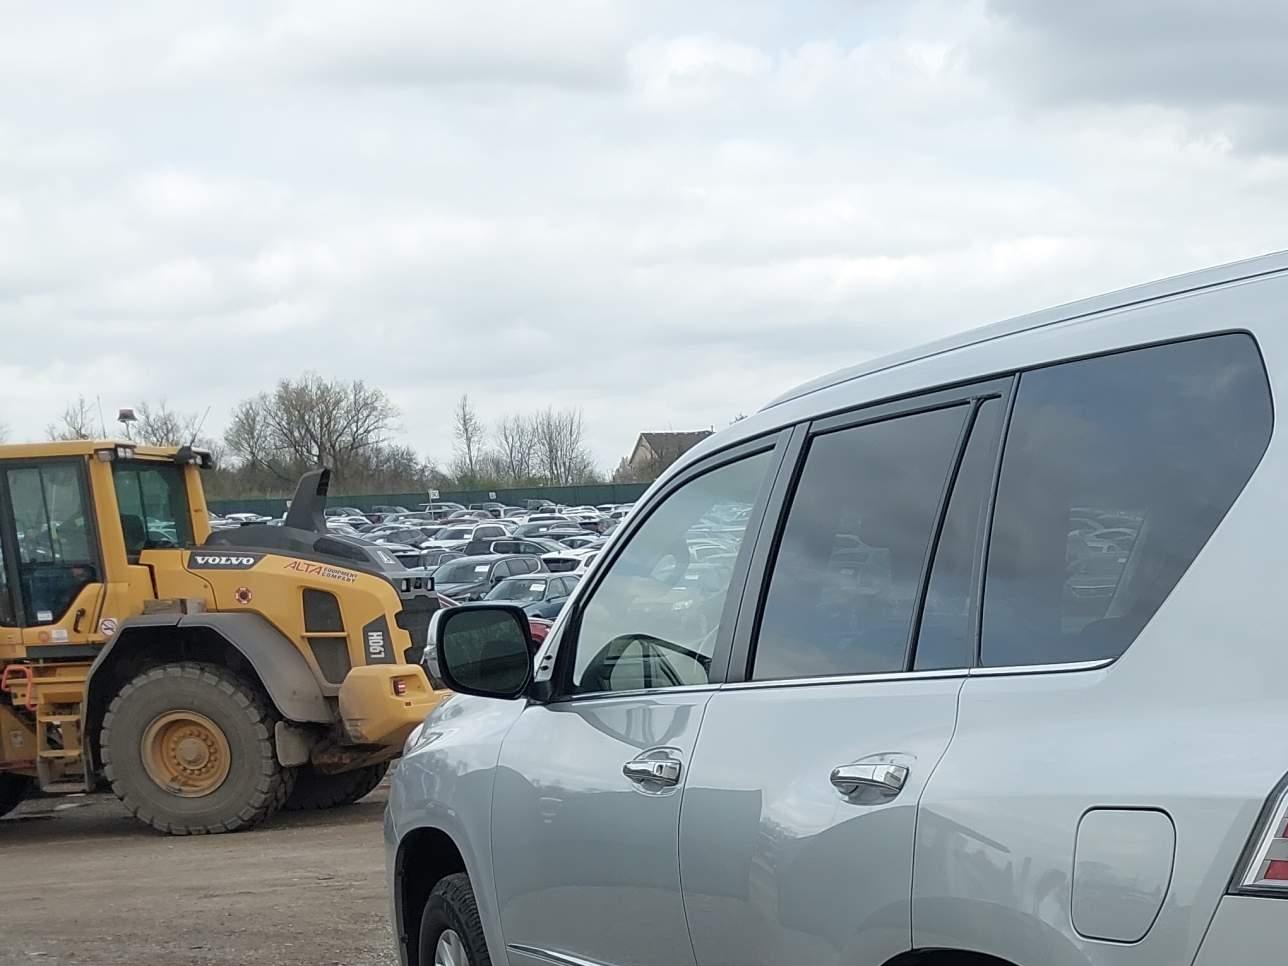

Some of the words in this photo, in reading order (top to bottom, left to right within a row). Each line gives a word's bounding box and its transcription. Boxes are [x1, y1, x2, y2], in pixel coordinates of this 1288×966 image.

[195, 556, 254, 565] VOLVO
[283, 560, 322, 576] ALTA
[322, 572, 355, 583] COMPANY
[367, 631, 385, 658] L90H
